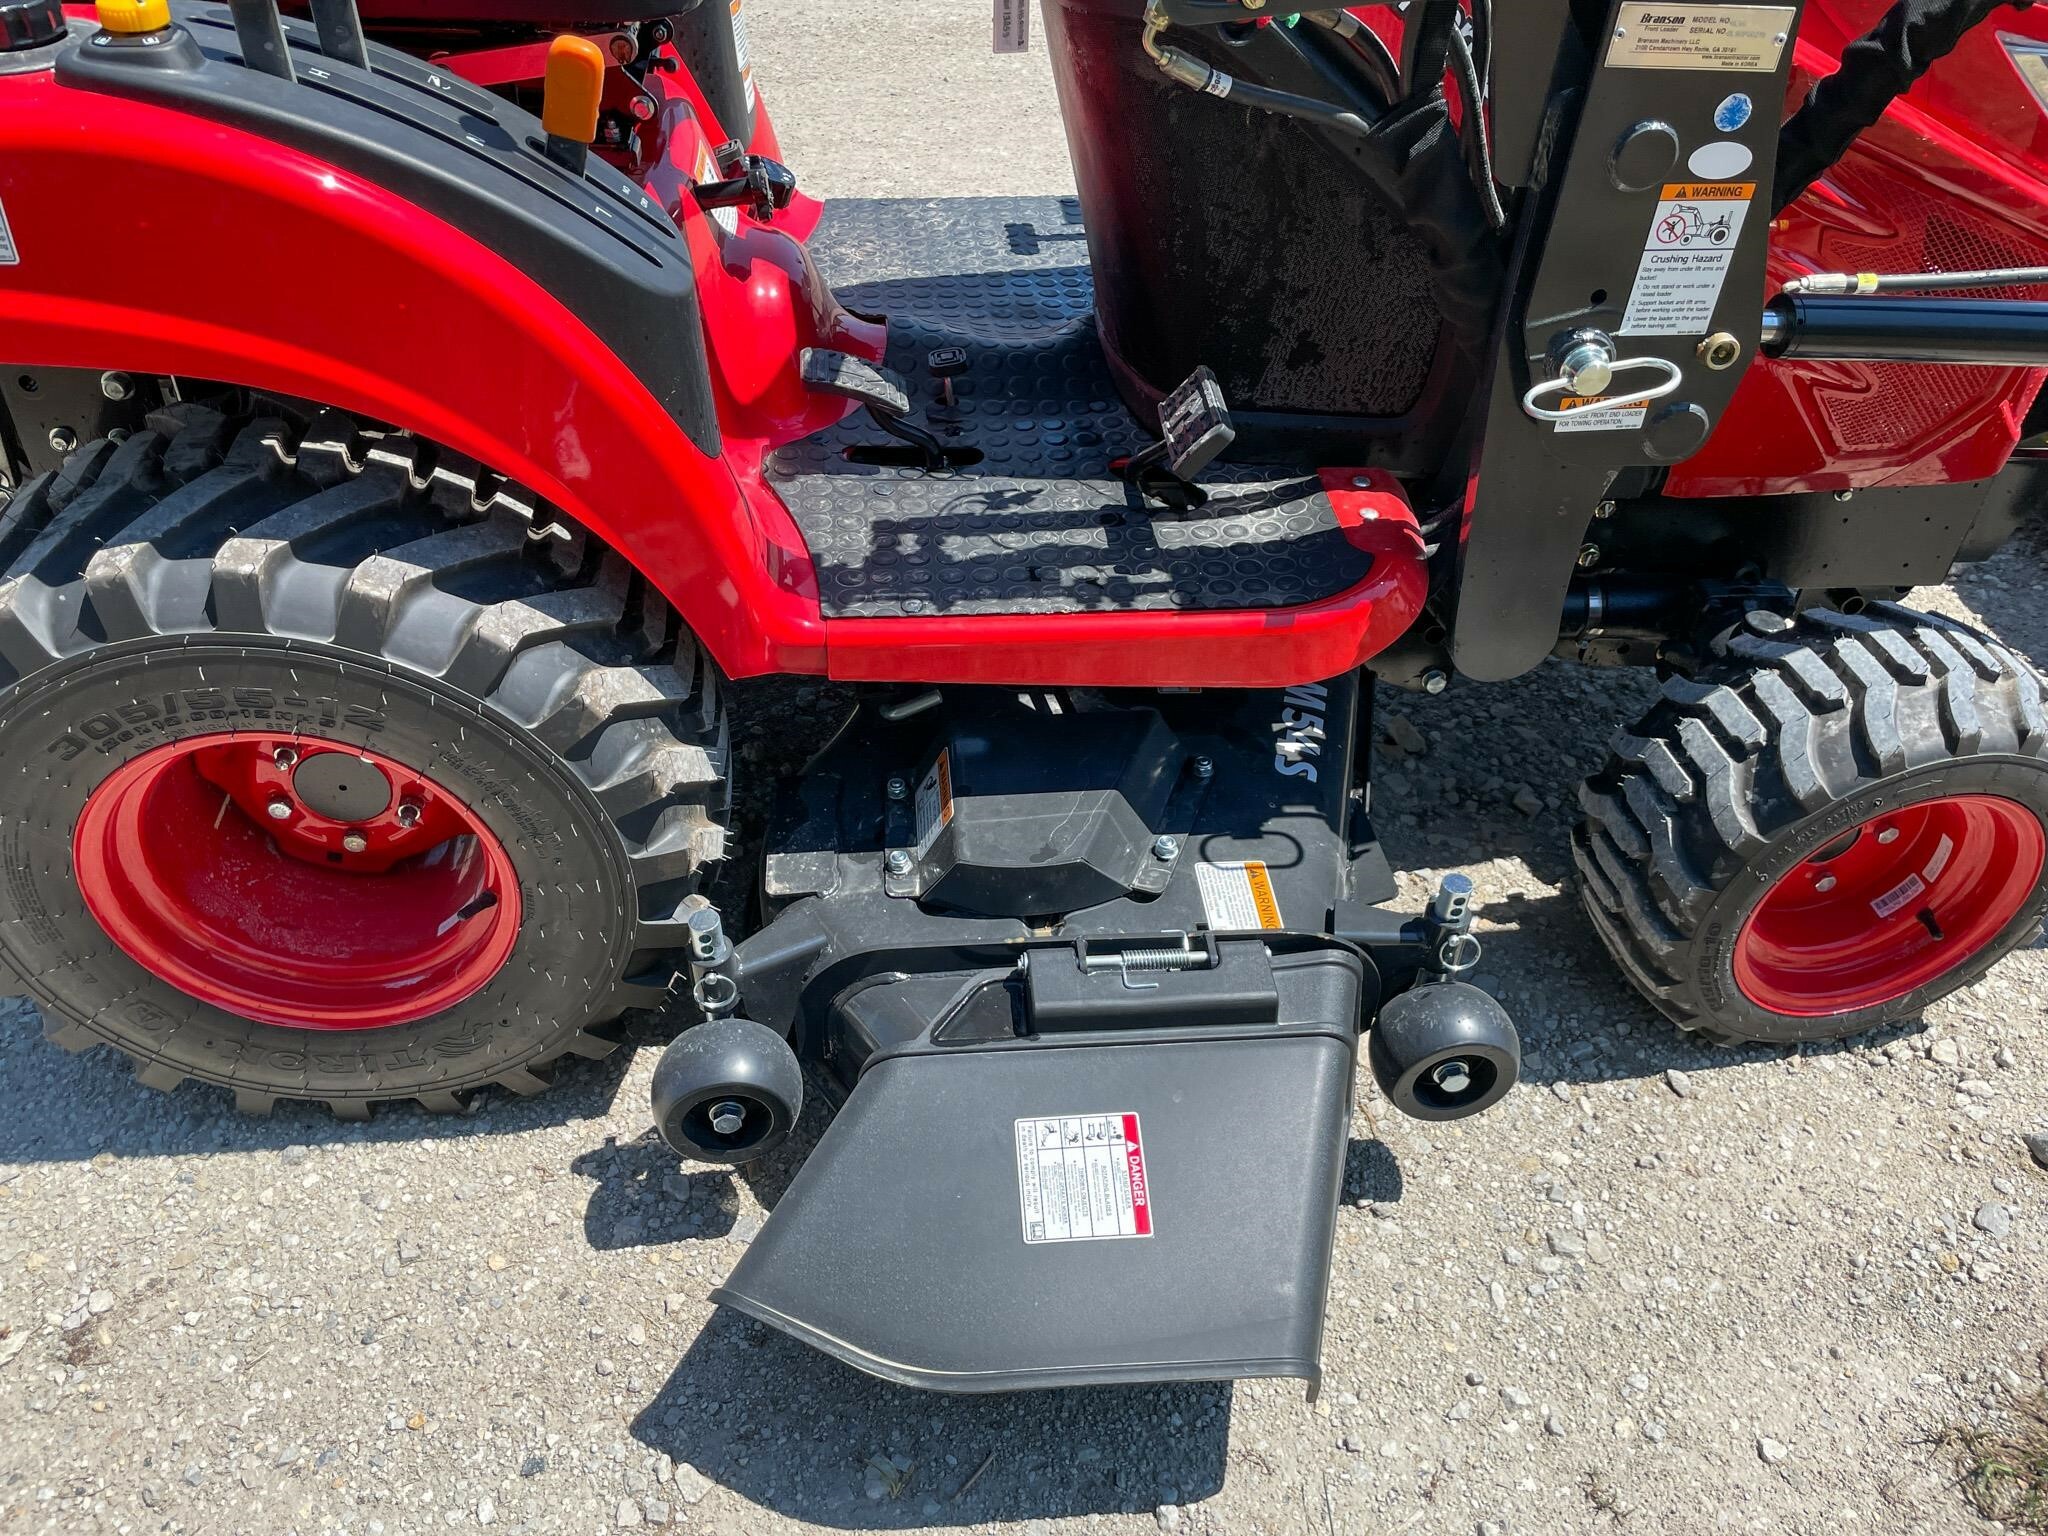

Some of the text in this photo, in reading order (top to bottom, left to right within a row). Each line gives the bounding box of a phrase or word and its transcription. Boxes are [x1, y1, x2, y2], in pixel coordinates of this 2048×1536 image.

[1640, 13, 1685, 24] Branson
[1692, 16, 1718, 24] MODEL
[1691, 186, 1743, 198] WARNING
[1650, 254, 1723, 265] Crushing Hazard
[1129, 1155, 1146, 1208] DANGER
